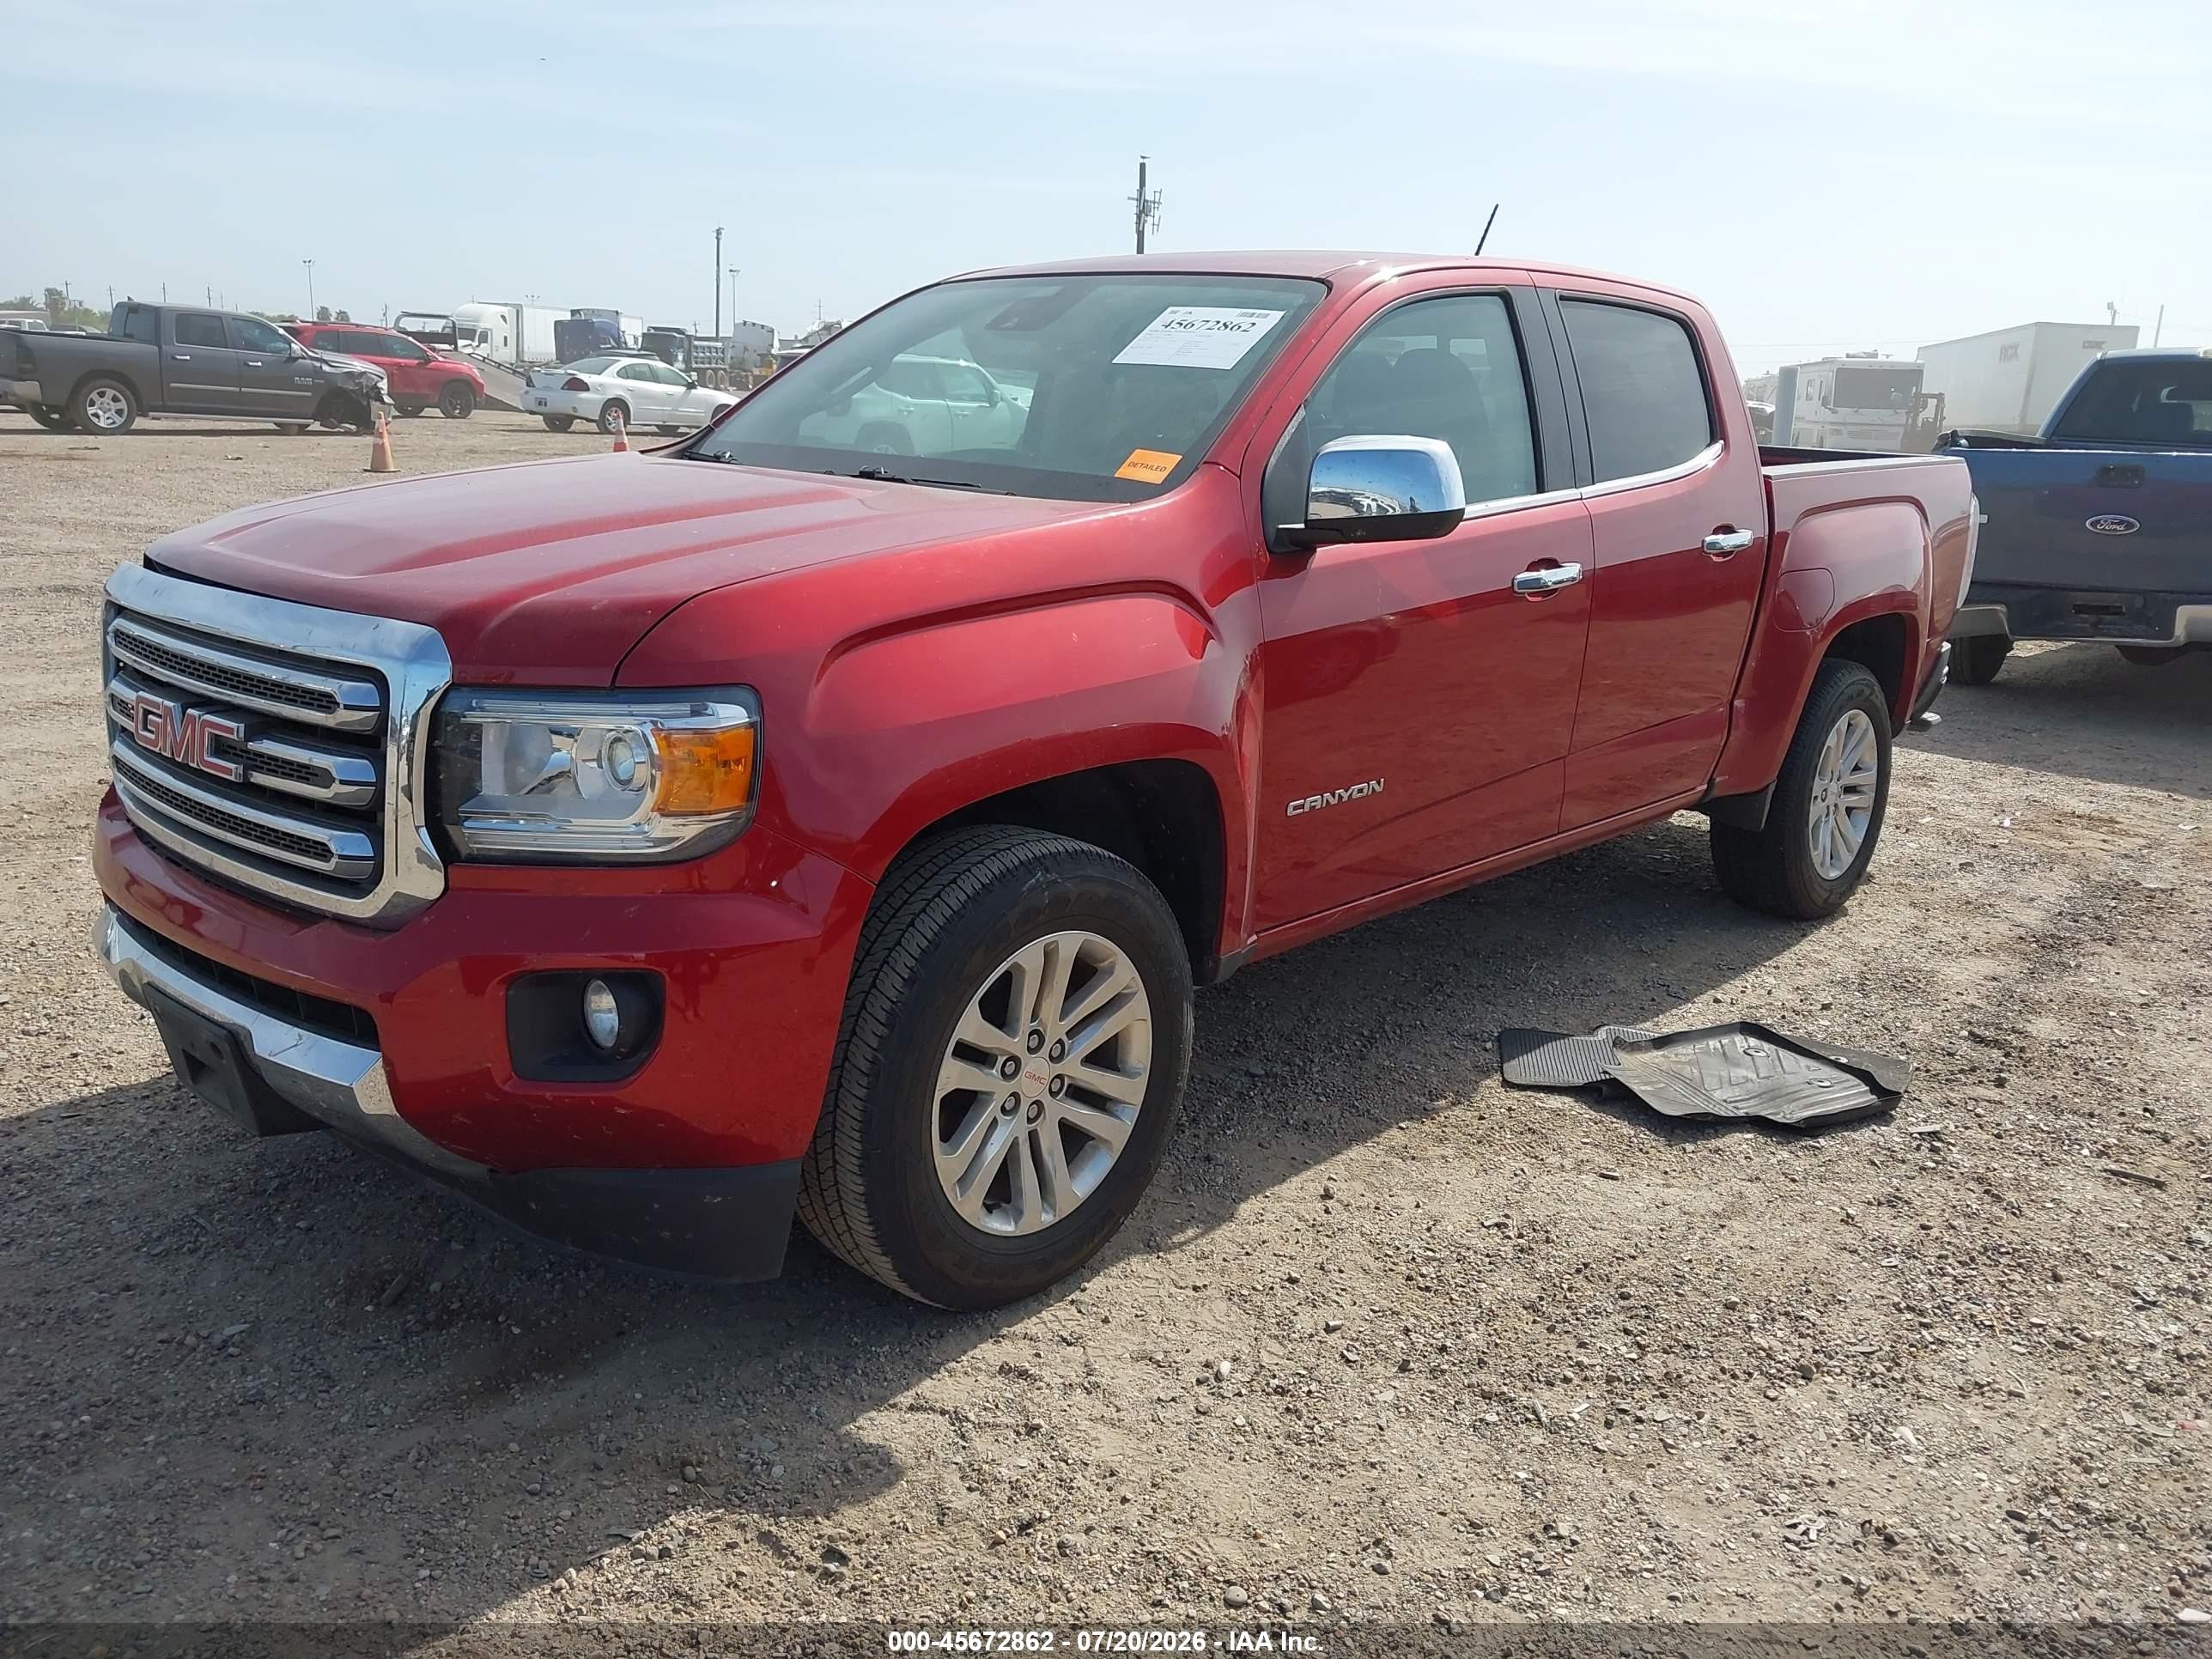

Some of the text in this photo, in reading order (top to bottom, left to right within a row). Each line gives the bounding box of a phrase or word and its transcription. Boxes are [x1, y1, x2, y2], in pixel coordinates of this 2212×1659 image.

[1160, 319, 1257, 333] 45672862
[1127, 461, 1167, 472] DETAILED
[2096, 519, 2127, 531] Ford
[134, 690, 245, 783] GMC
[1287, 778, 1385, 817] CANYON
[1024, 1071, 1047, 1085] GMC
